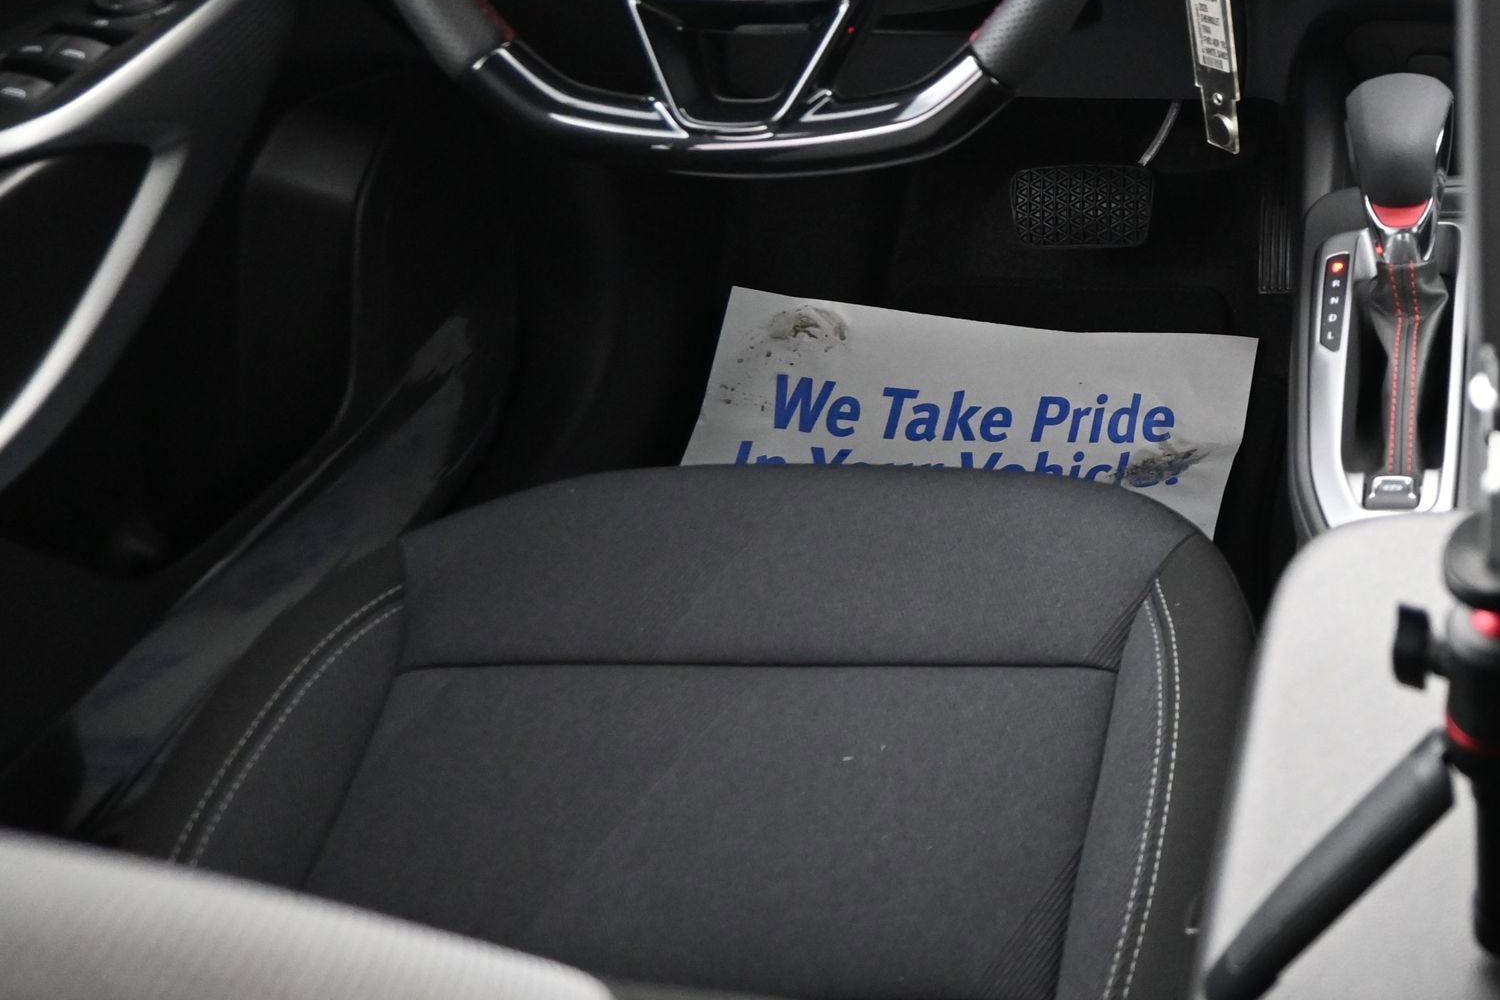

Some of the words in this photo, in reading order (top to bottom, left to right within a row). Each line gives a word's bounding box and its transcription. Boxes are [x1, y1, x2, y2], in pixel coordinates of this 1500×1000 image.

[1331, 262, 1343, 273] P
[1331, 279, 1340, 288] R
[1330, 296, 1339, 305] N
[1328, 313, 1338, 323] D
[1326, 331, 1334, 340] L
[773, 374, 861, 438] We
[882, 386, 1013, 443] Take
[1030, 393, 1175, 444] Pride
